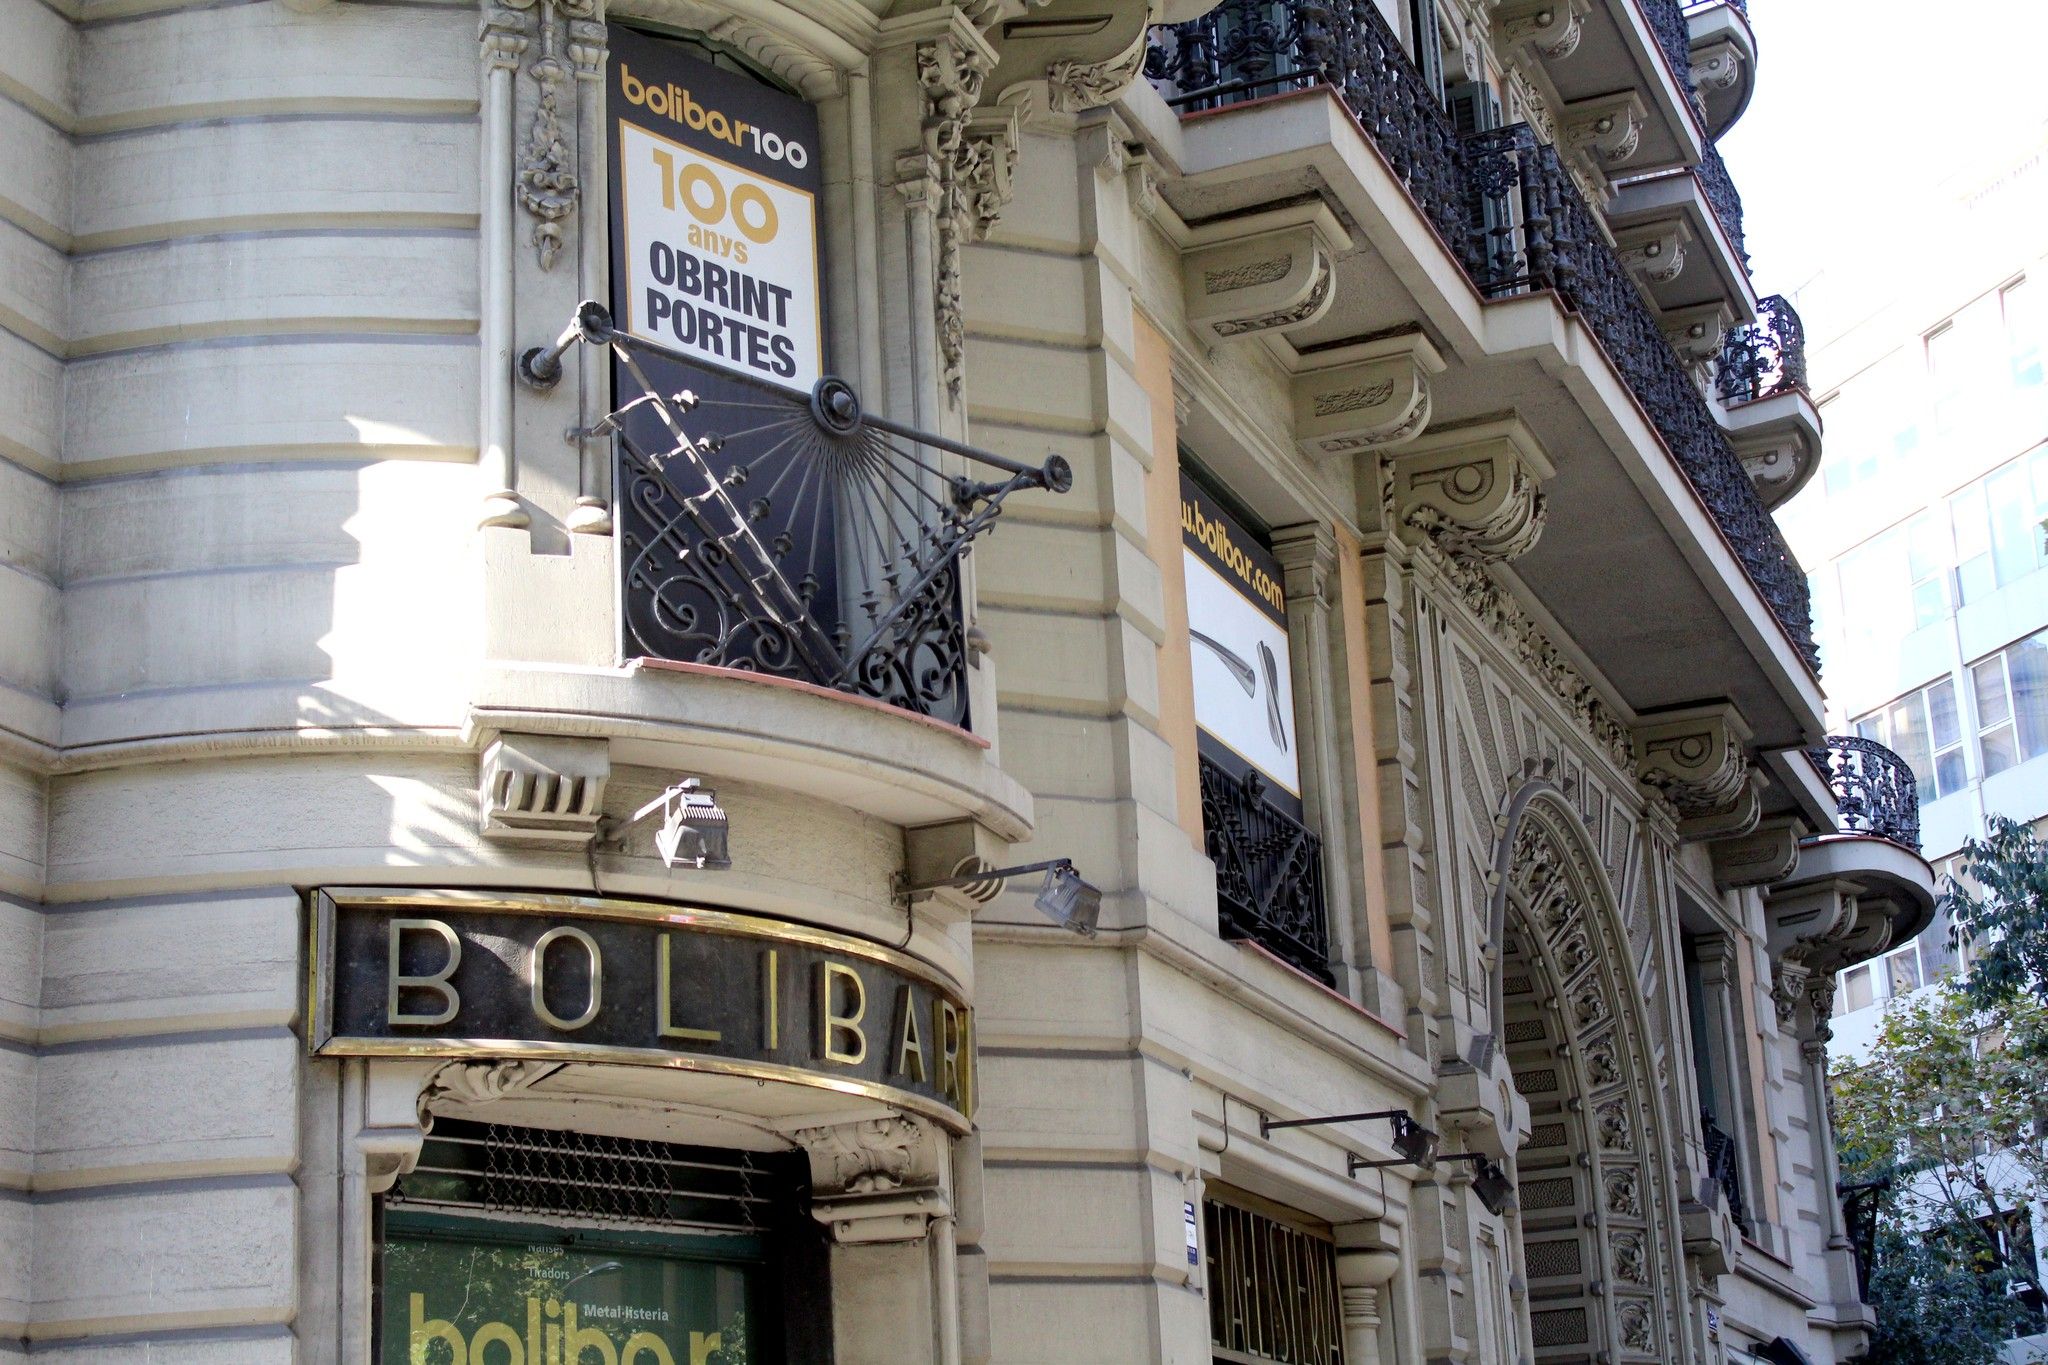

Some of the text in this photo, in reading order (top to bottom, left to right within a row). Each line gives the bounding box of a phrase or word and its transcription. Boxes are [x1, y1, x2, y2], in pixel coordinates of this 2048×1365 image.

[620, 62, 808, 169] bolibar100
[652, 147, 779, 245] 100
[649, 241, 792, 328] OBRINT
[687, 223, 749, 265] anys
[646, 287, 797, 378] PORTES
[386, 918, 960, 1101] BOLIBAR
[528, 1267, 570, 1280] Tiradors
[410, 1292, 721, 1365] bolibar
